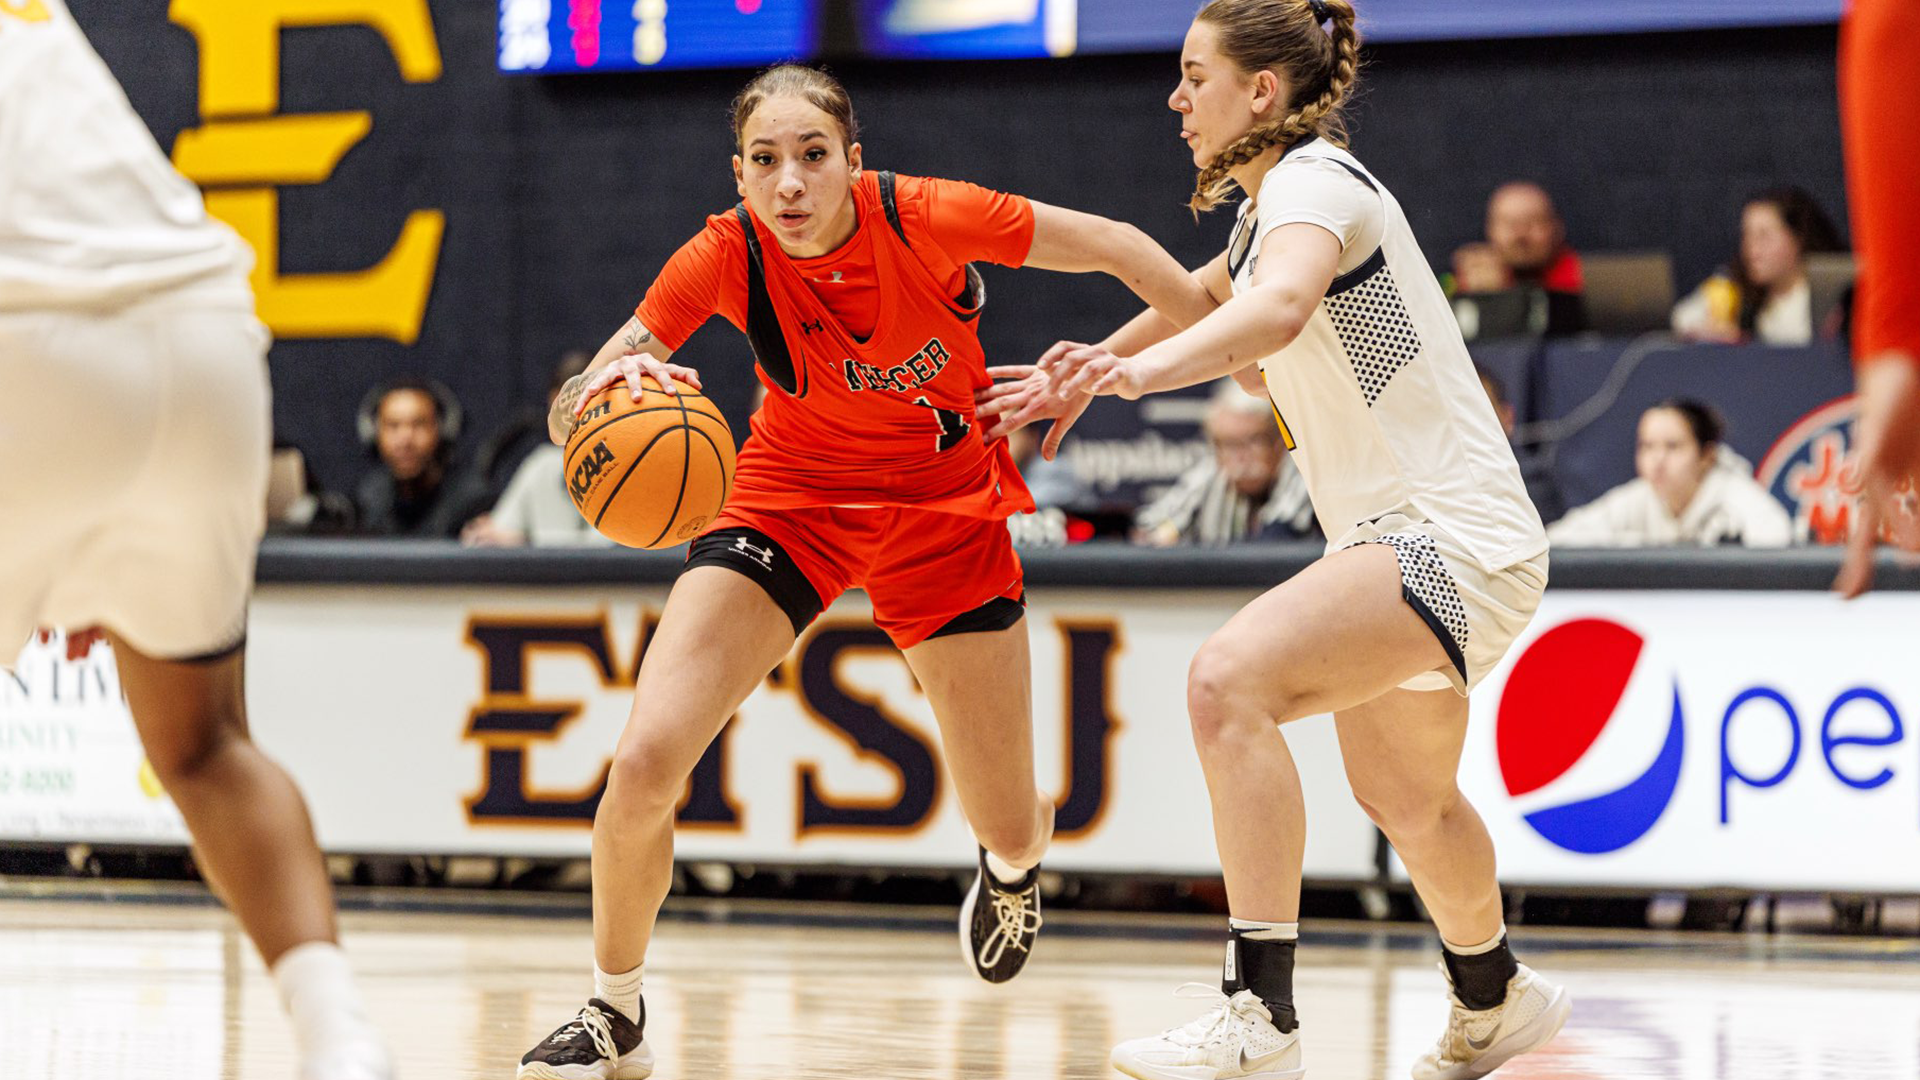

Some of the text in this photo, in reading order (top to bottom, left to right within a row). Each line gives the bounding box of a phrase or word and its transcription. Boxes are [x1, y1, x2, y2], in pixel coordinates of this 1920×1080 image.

[167, 0, 446, 346] E
[829, 337, 951, 393] MCER
[570, 439, 616, 510] NCAA
[1719, 686, 1920, 824] pe
